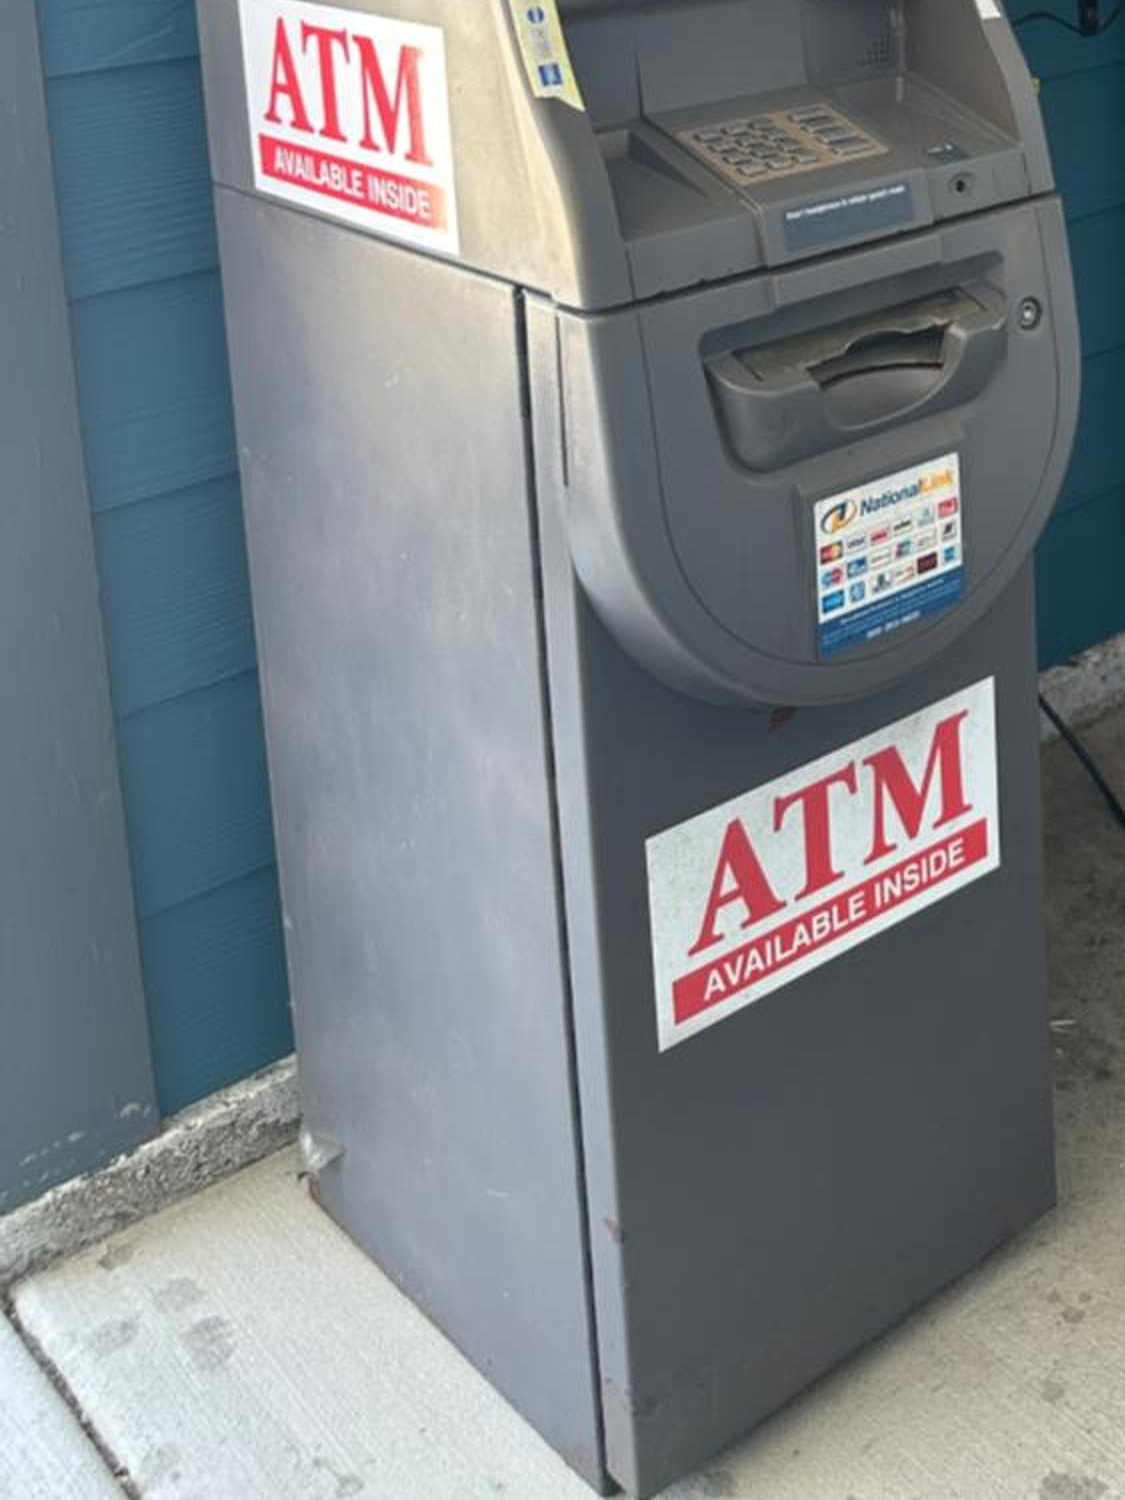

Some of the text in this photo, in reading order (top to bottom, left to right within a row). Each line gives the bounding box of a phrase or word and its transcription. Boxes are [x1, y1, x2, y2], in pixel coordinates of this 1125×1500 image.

[263, 15, 434, 168] ATM
[274, 145, 432, 220] AVAILABLE INSIDE
[687, 708, 974, 957] ATM
[703, 836, 966, 1001] AVAILABLE INSIDE
